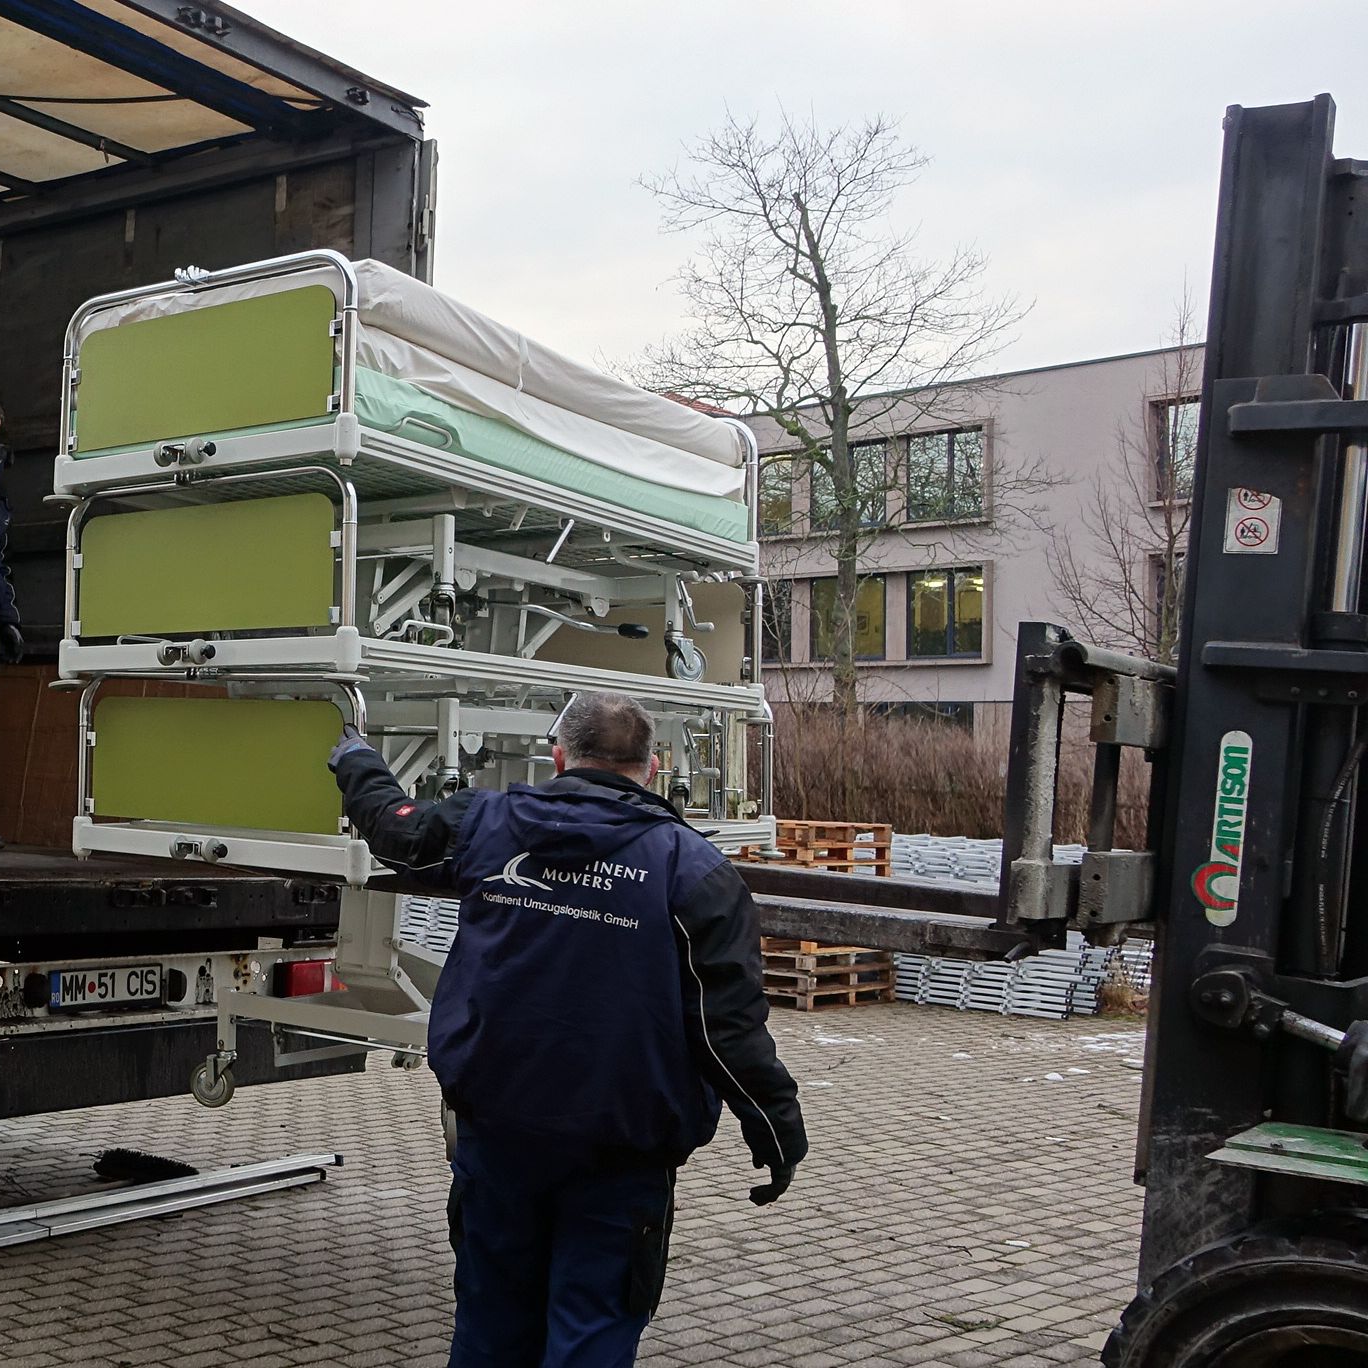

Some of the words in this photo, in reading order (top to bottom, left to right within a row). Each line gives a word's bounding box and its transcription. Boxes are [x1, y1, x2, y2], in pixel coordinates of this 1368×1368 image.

[542, 867, 613, 891] MOVERS
[585, 860, 649, 883] INENT
[482, 891, 522, 907] Kontinent
[523, 898, 601, 922] Umzugslogistik
[603, 912, 639, 930] GmbH
[62, 973, 87, 1003] MM
[97, 972, 116, 999] 51
[126, 969, 157, 997] CIS
